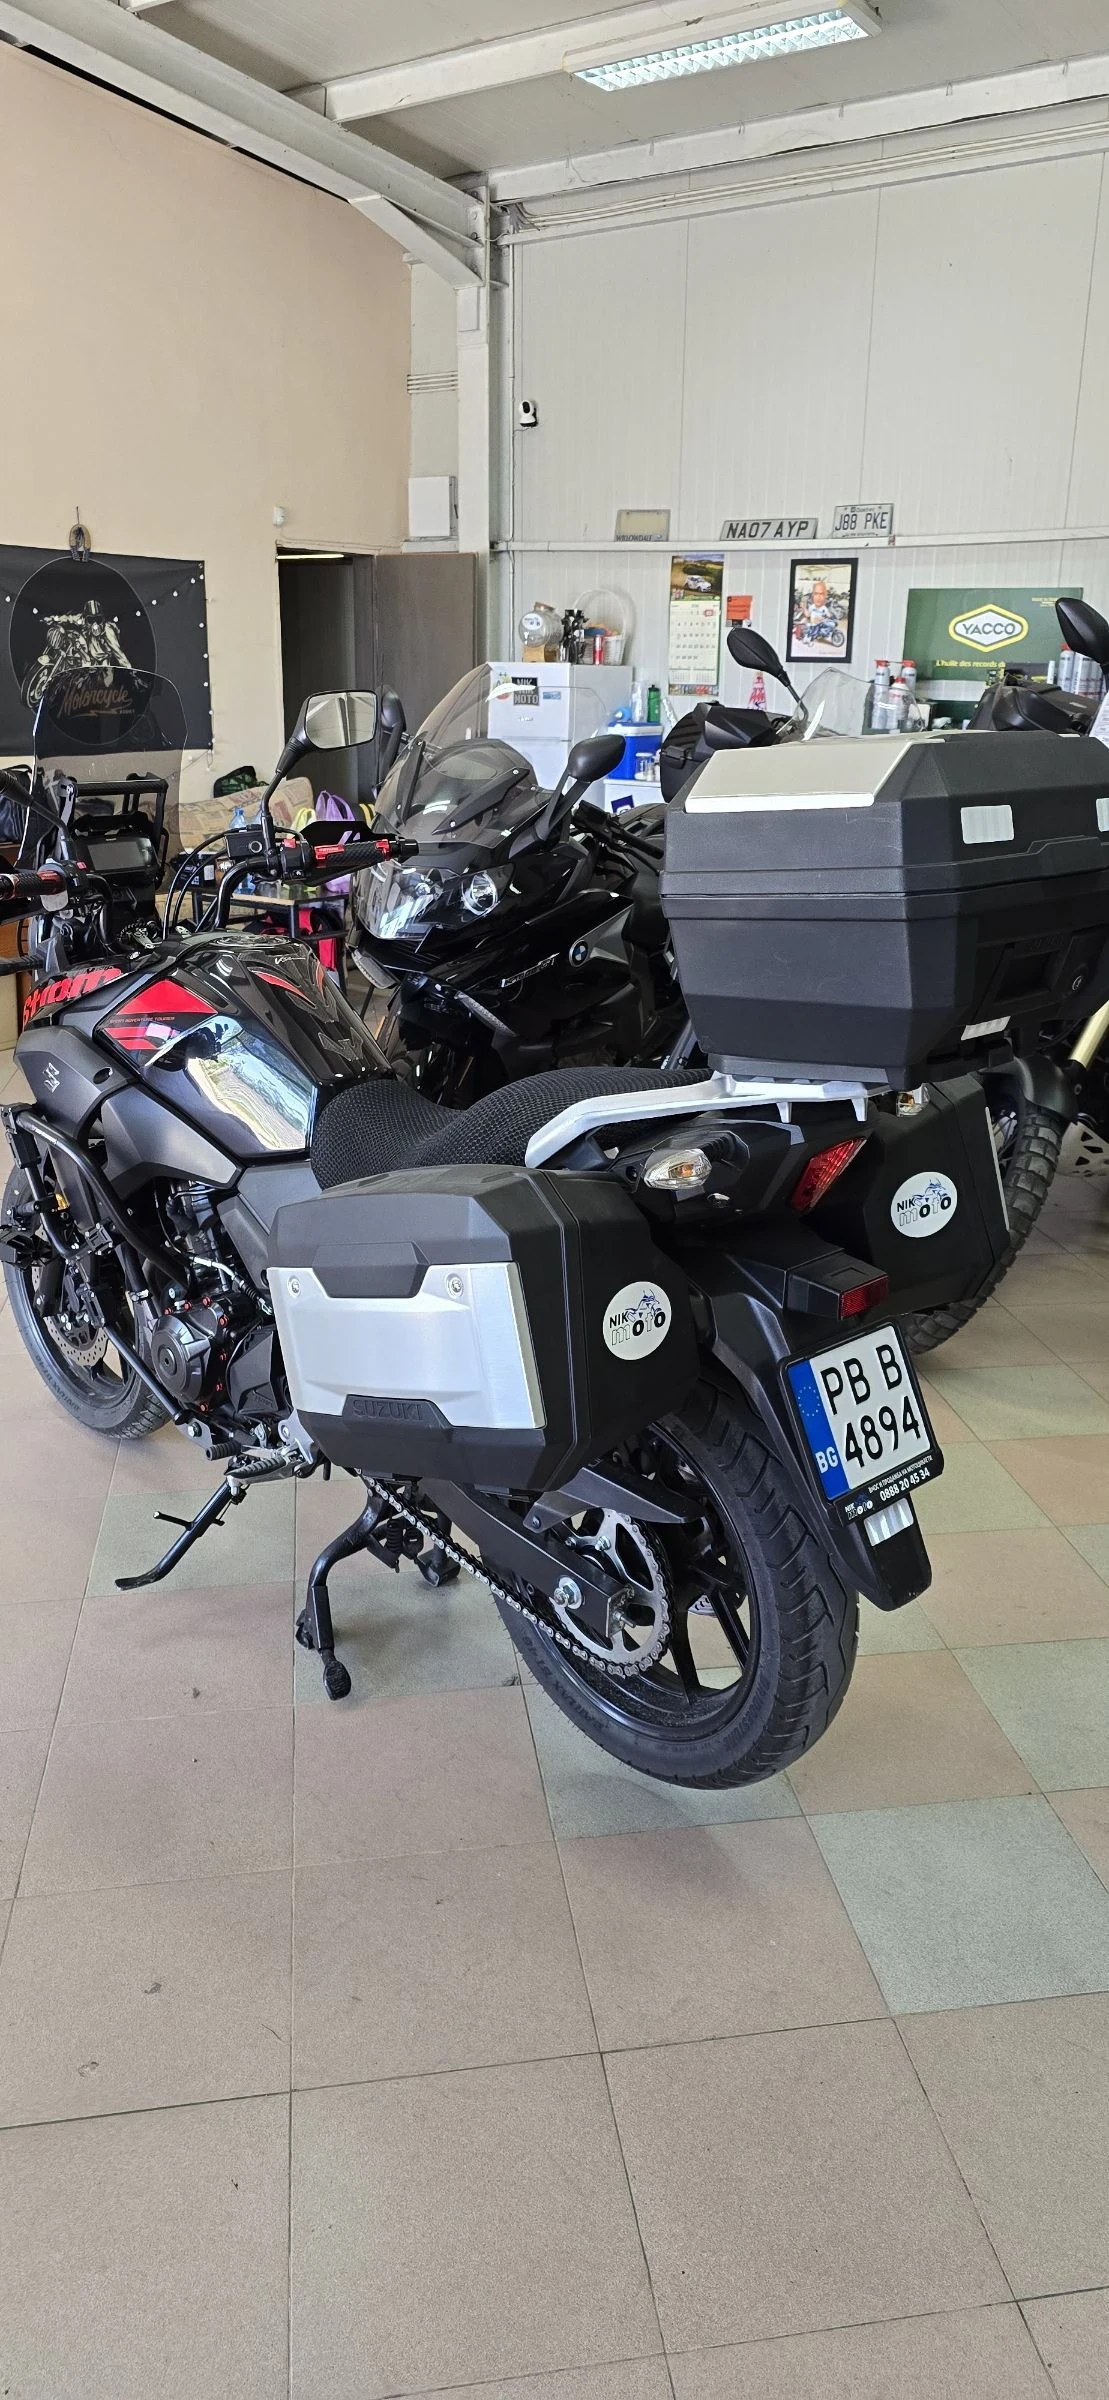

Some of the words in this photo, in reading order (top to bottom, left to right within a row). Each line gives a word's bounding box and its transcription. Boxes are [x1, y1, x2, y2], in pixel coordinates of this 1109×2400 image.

[726, 521, 771, 539] NA07
[774, 520, 809, 538] AYP
[835, 513, 857, 531] J88
[864, 511, 888, 530] PKE
[962, 623, 1016, 635] YACCO
[57, 684, 132, 718] Motorcycle
[514, 694, 539, 704] MOTO
[897, 1196, 915, 1212] NIK
[899, 1196, 952, 1227] moto
[609, 1310, 629, 1329] NIK
[612, 1311, 666, 1346] moto
[820, 1357, 871, 1415] PB
[875, 1344, 903, 1390] B
[353, 1399, 422, 1421] SUZUKI
[845, 1395, 921, 1468] 4894
[815, 1446, 839, 1474] BG
[879, 1483, 900, 1502] 0888
[899, 1478, 910, 1492] 20
[910, 1473, 920, 1485] 45
[919, 1466, 931, 1480] 34
[845, 1502, 855, 1513] NIK
